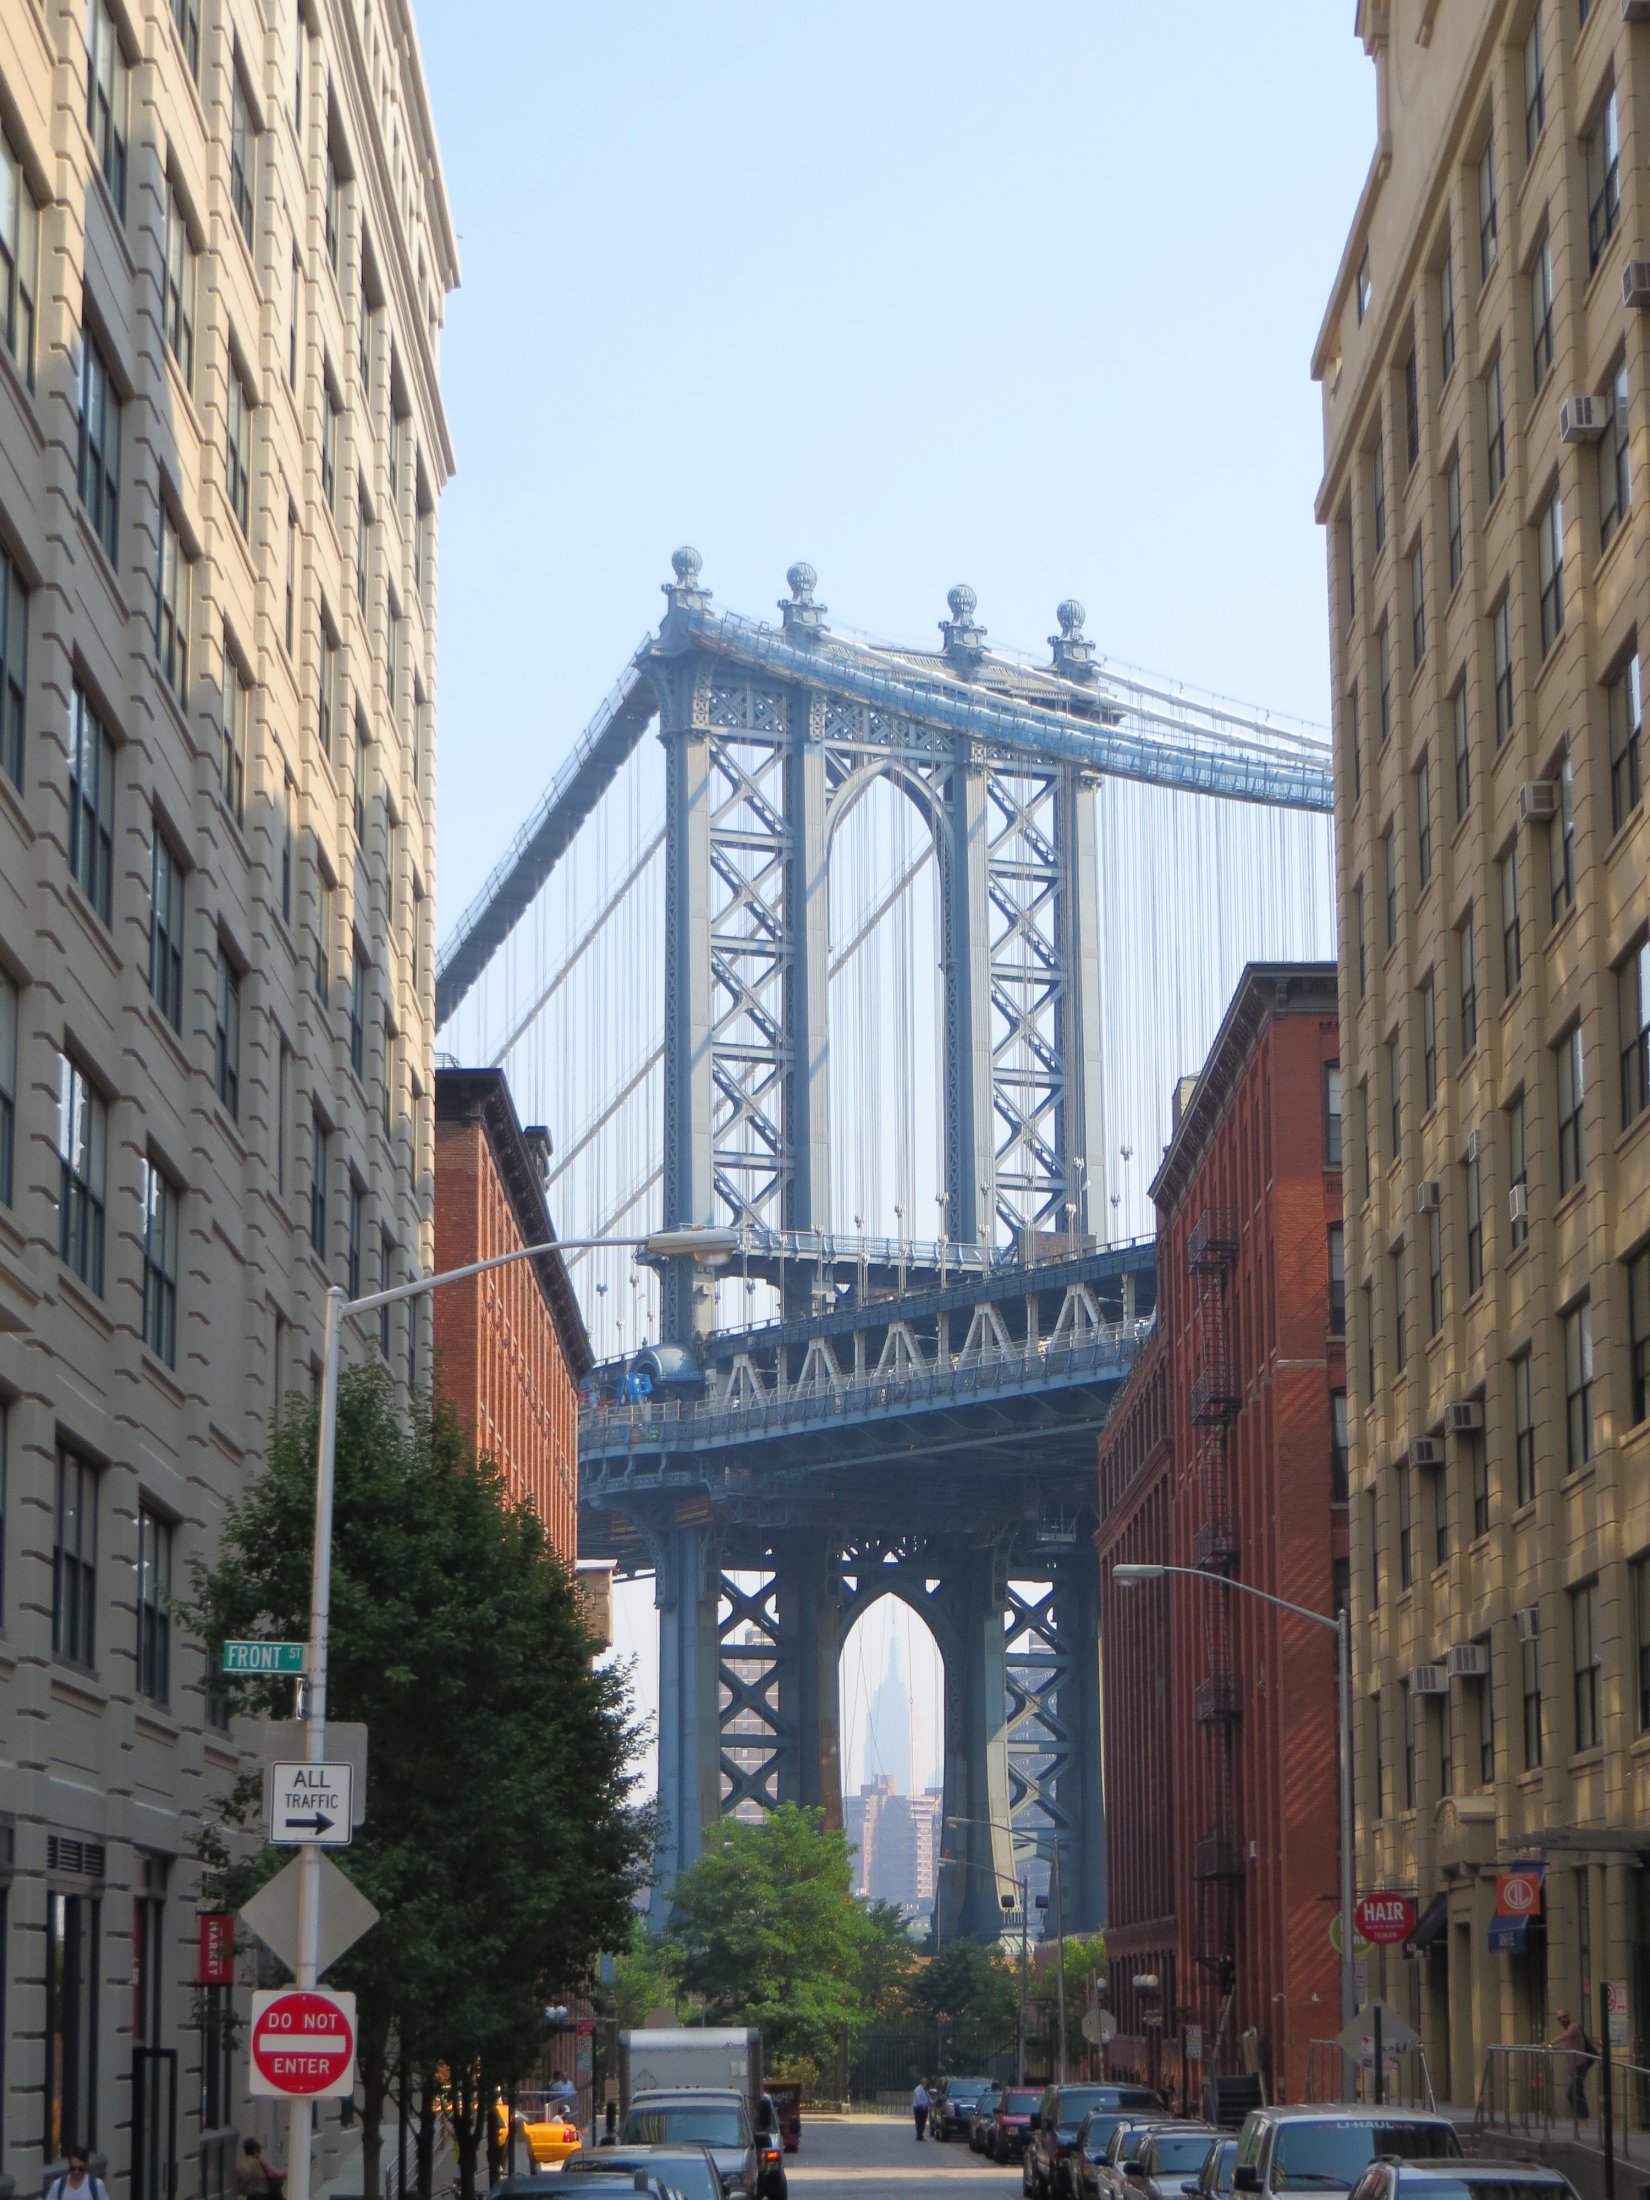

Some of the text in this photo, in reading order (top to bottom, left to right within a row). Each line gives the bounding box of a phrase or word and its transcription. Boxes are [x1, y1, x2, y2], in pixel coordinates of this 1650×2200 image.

[228, 1645, 301, 1669] FRONT ST
[293, 1770, 331, 1788] ALL
[285, 1794, 338, 1809] TRAFFIC
[1363, 1902, 1404, 1921] HAIR
[208, 1921, 218, 1976] MARKET
[269, 2013, 338, 2029] DO NOT
[274, 2058, 330, 2074] ENTER
